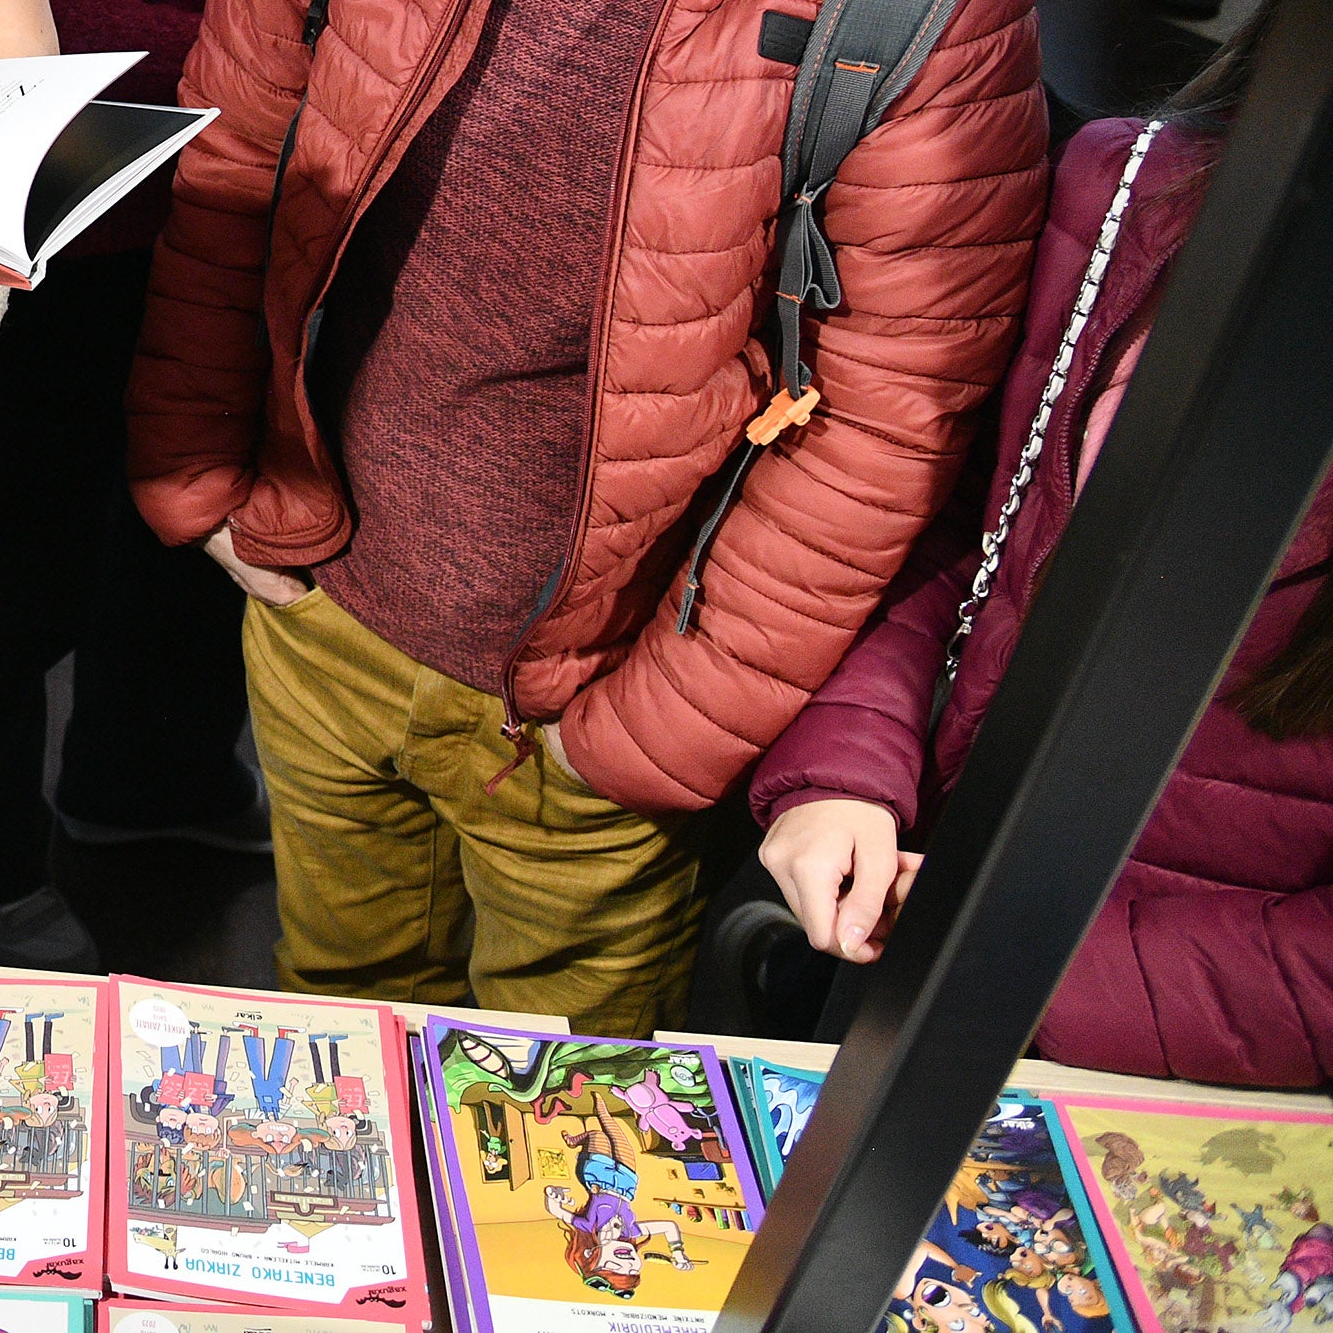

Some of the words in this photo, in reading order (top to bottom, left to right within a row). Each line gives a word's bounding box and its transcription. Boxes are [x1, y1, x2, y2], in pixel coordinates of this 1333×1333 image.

[233, 1011, 263, 1021] elkar
[160, 1025, 186, 1035] MIKEL
[1001, 1119, 1036, 1131] elkar
[63, 1237, 77, 1248] 10
[200, 1247, 228, 1257] HIDALGO
[185, 1257, 242, 1278] ZIRKUA
[304, 1259, 335, 1268] KARMELE
[381, 1264, 397, 1276] 10
[251, 1266, 336, 1287] BENETAKO
[571, 1308, 606, 1319] MORKOTS
[620, 1311, 668, 1322] MENDIZABAL
